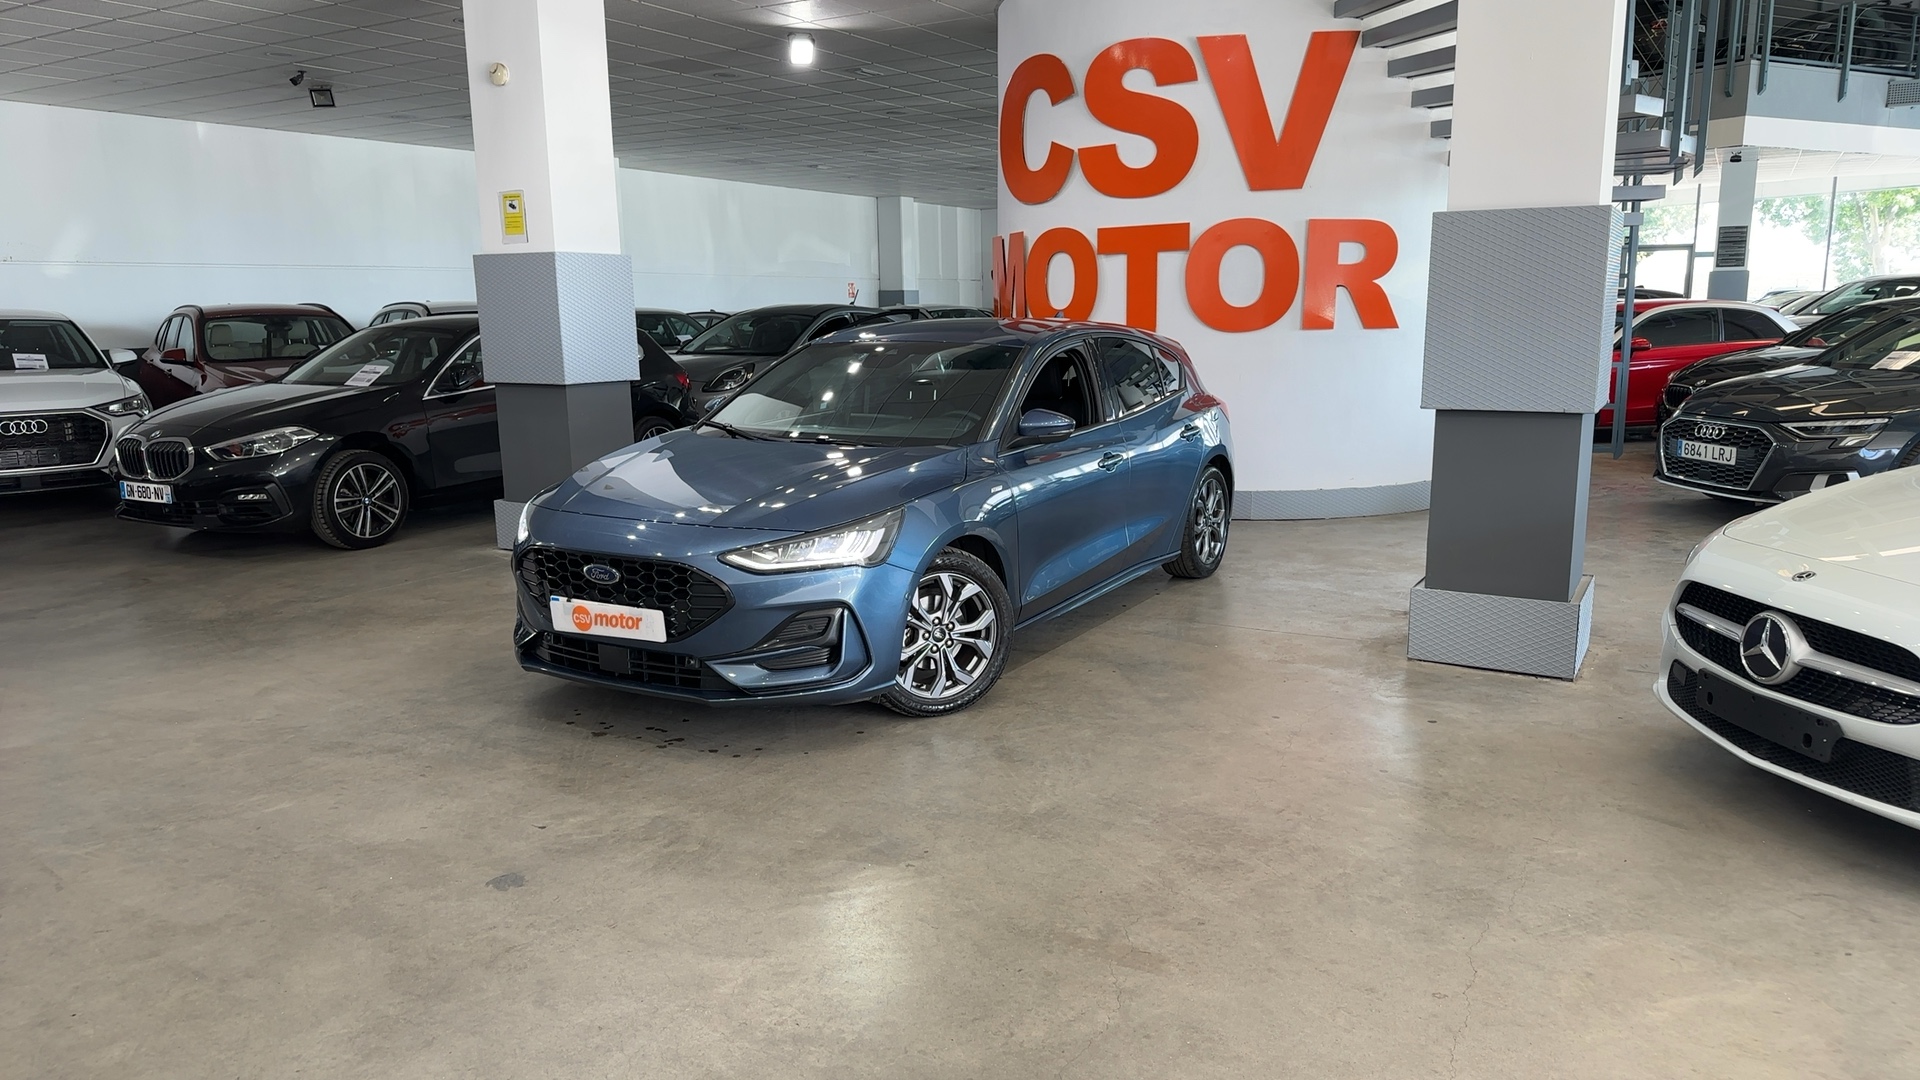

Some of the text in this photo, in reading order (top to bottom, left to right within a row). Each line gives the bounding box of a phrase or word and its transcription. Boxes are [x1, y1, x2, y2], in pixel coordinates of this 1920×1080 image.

[1000, 30, 1362, 204] CSV
[992, 217, 1399, 333] MOTOR
[1684, 442, 1733, 462] 6841 LRJ
[590, 567, 610, 581] Ford
[573, 612, 643, 630] CSV motor
